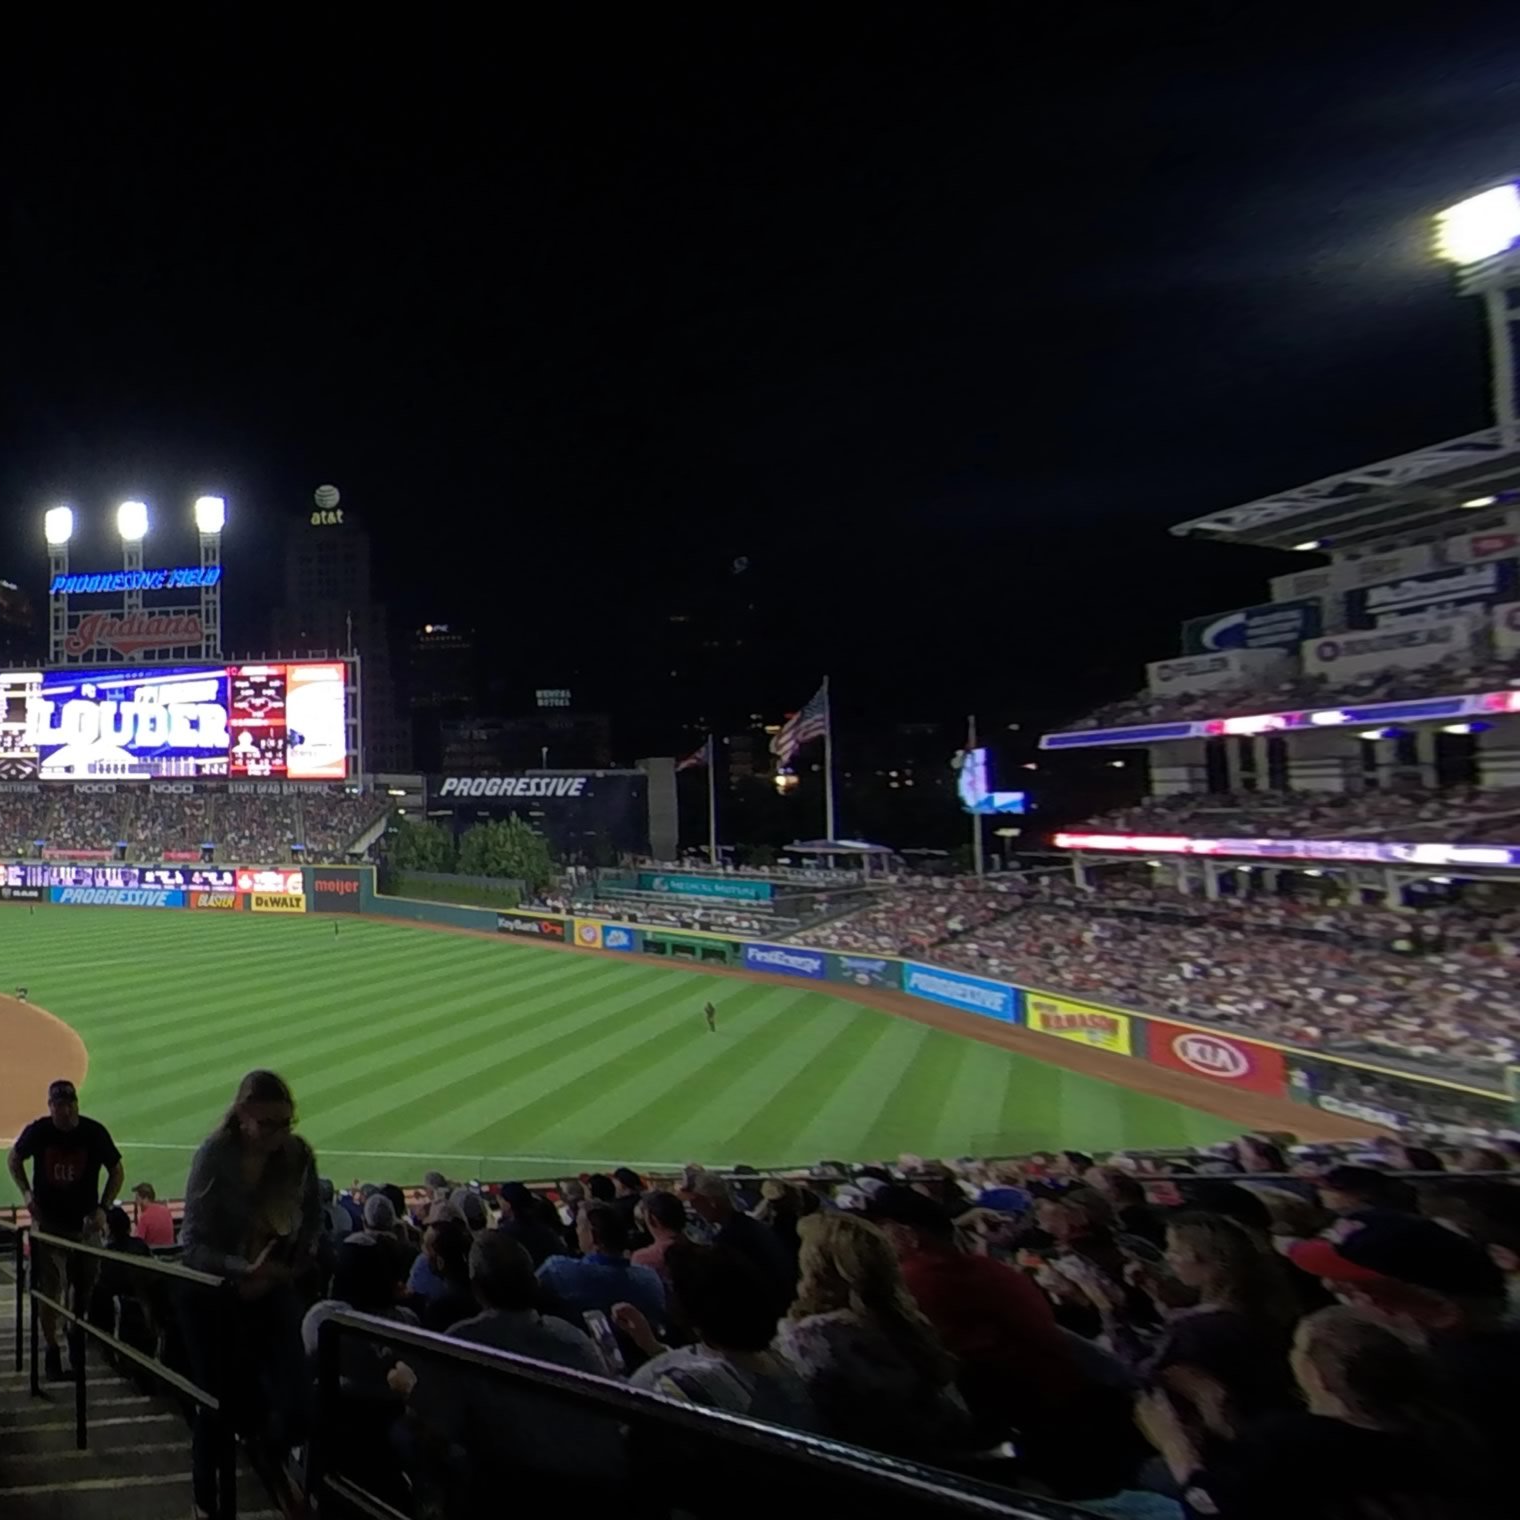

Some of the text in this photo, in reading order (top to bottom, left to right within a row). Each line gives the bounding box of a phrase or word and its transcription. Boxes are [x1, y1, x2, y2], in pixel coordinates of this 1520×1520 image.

[310, 509, 344, 525] at&t
[50, 567, 221, 594] PROGRESSIVE FIELD
[65, 612, 204, 656] Indians
[27, 698, 230, 749] LOUDER
[73, 783, 116, 793] NOCO
[150, 783, 194, 794] NOCO
[440, 777, 587, 797] PROGRESSIVE
[314, 879, 359, 895] meijer
[60, 888, 171, 907] PROGRESSIVE
[497, 917, 540, 933] KeyBank
[747, 947, 821, 973] FirstEnergy
[908, 972, 1008, 1012] PROGRESSIVE
[1185, 1038, 1235, 1072] KIA
[54, 1163, 75, 1181] CLE
